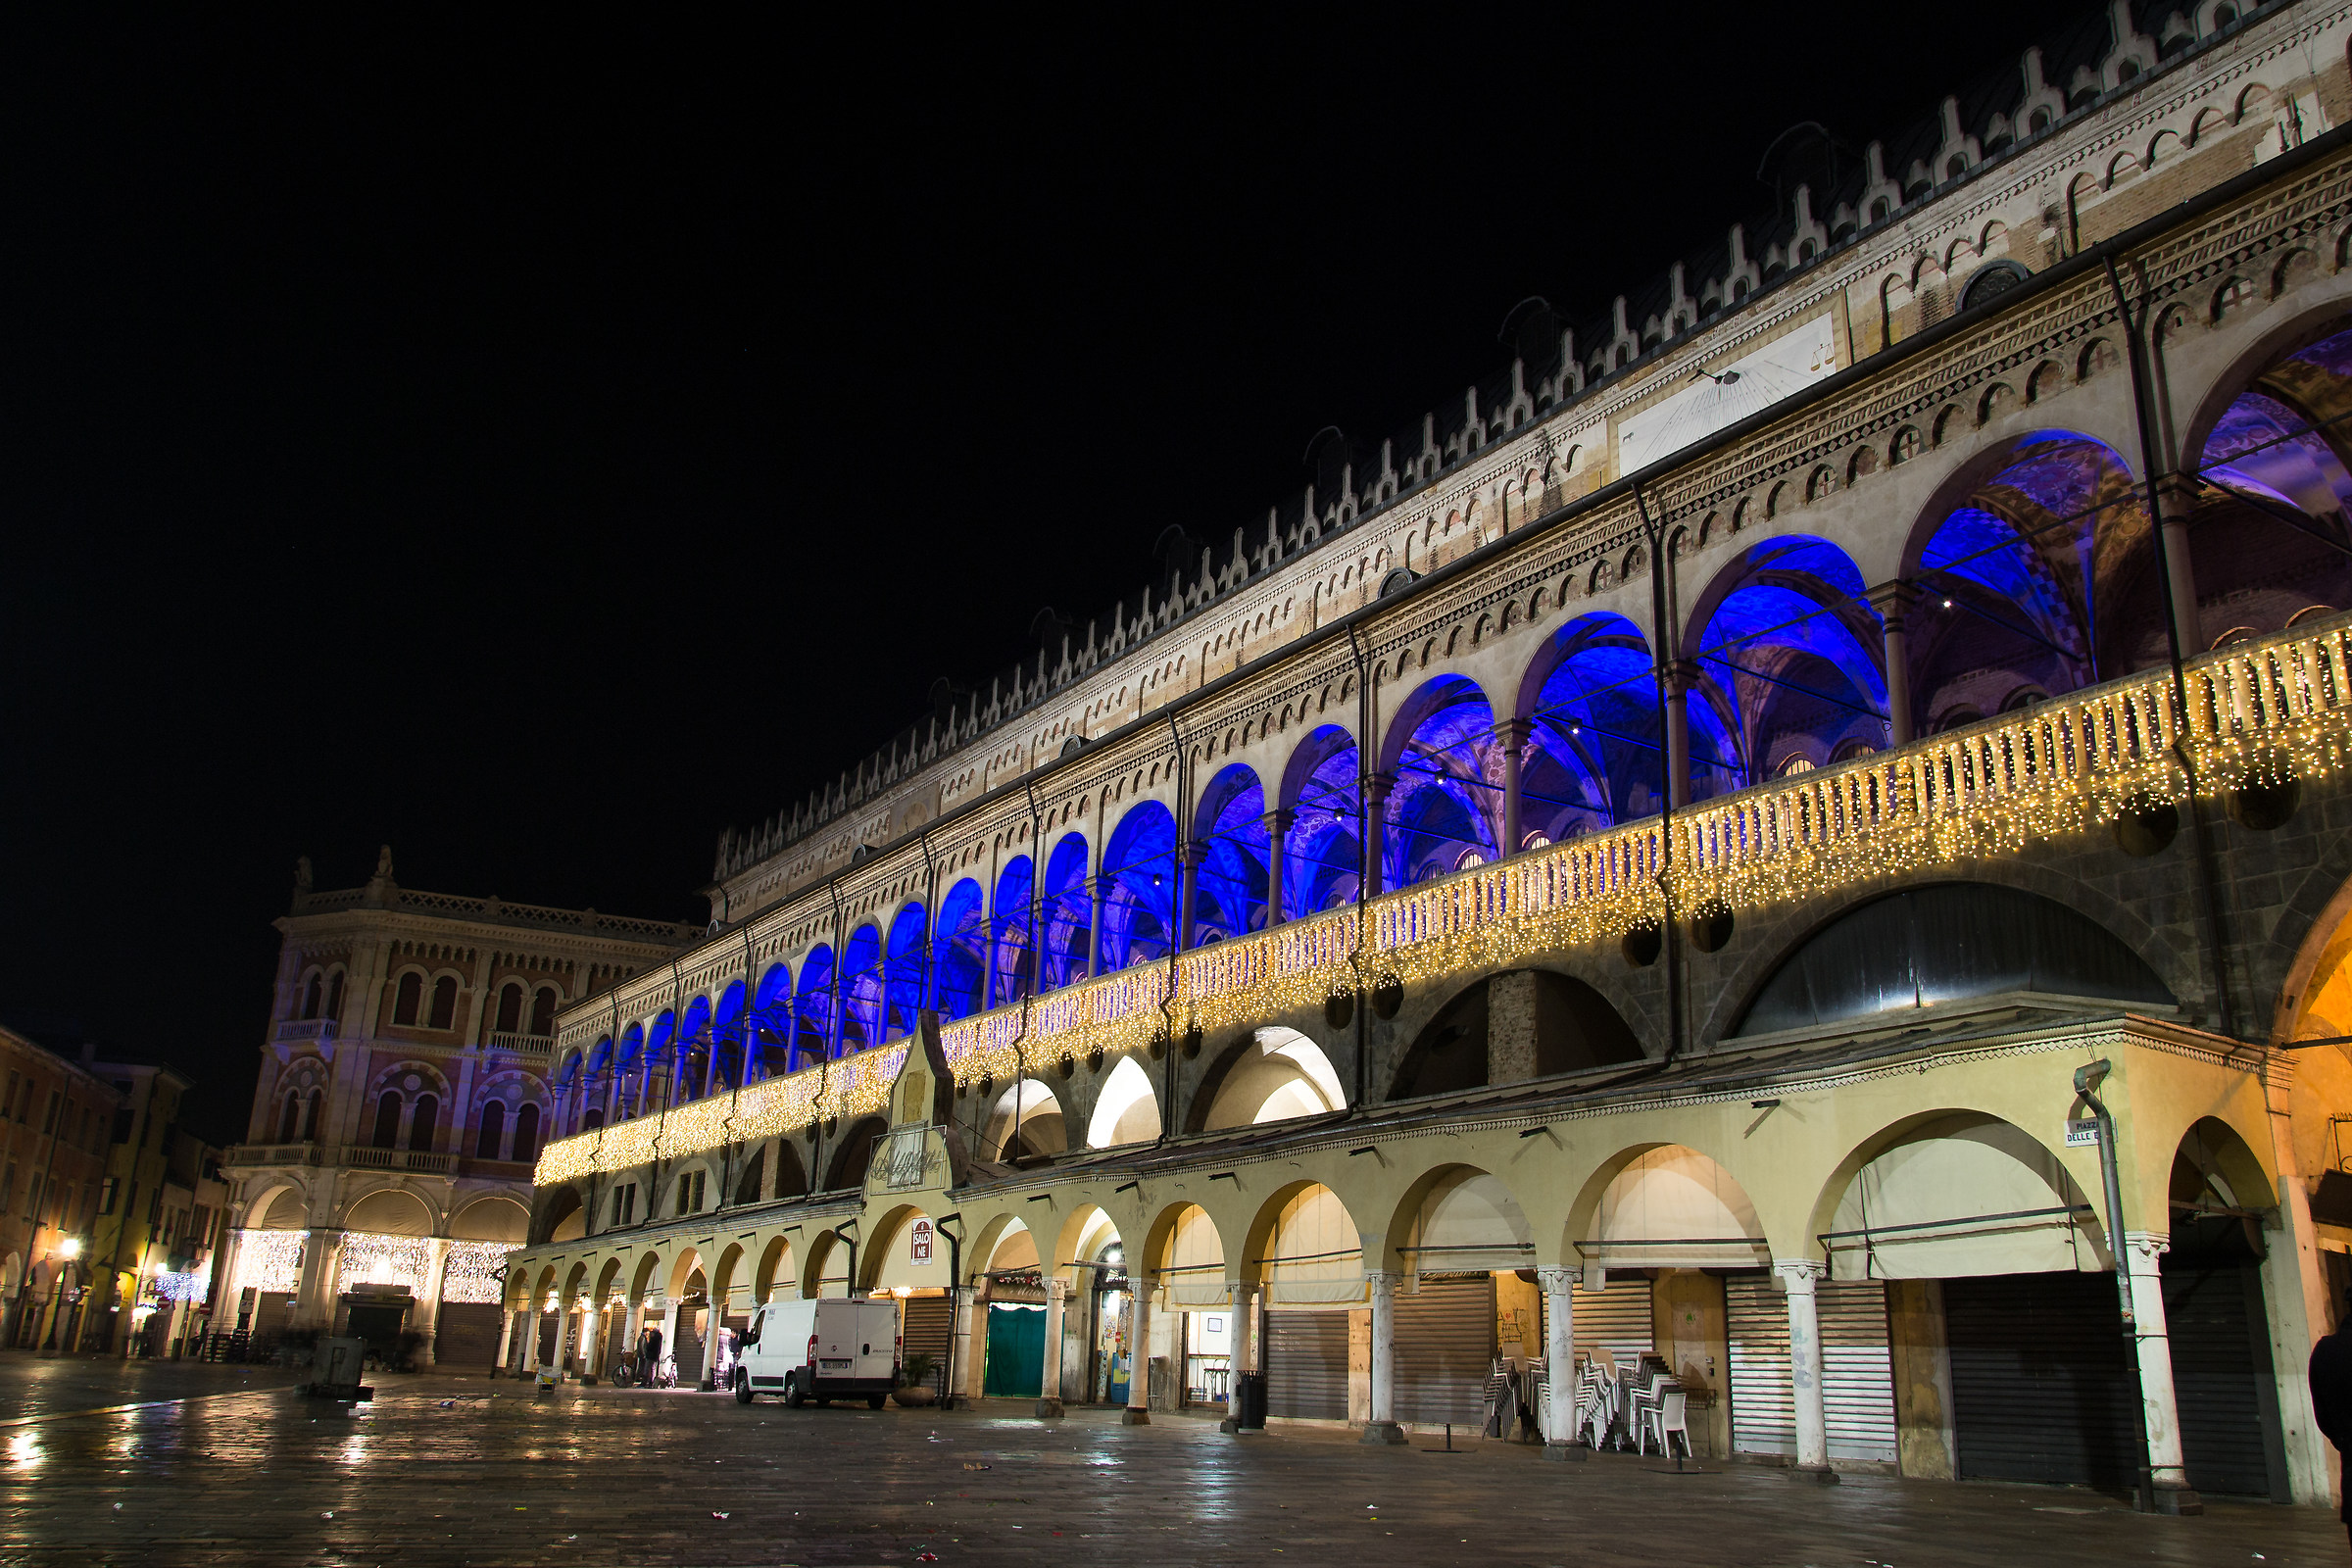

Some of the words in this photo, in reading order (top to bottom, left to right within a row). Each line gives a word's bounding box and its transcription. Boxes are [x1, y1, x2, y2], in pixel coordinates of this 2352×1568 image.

[2067, 1132, 2090, 1142] DELLE
[914, 1233, 929, 1245] SALO
[917, 1246, 926, 1257] NE
